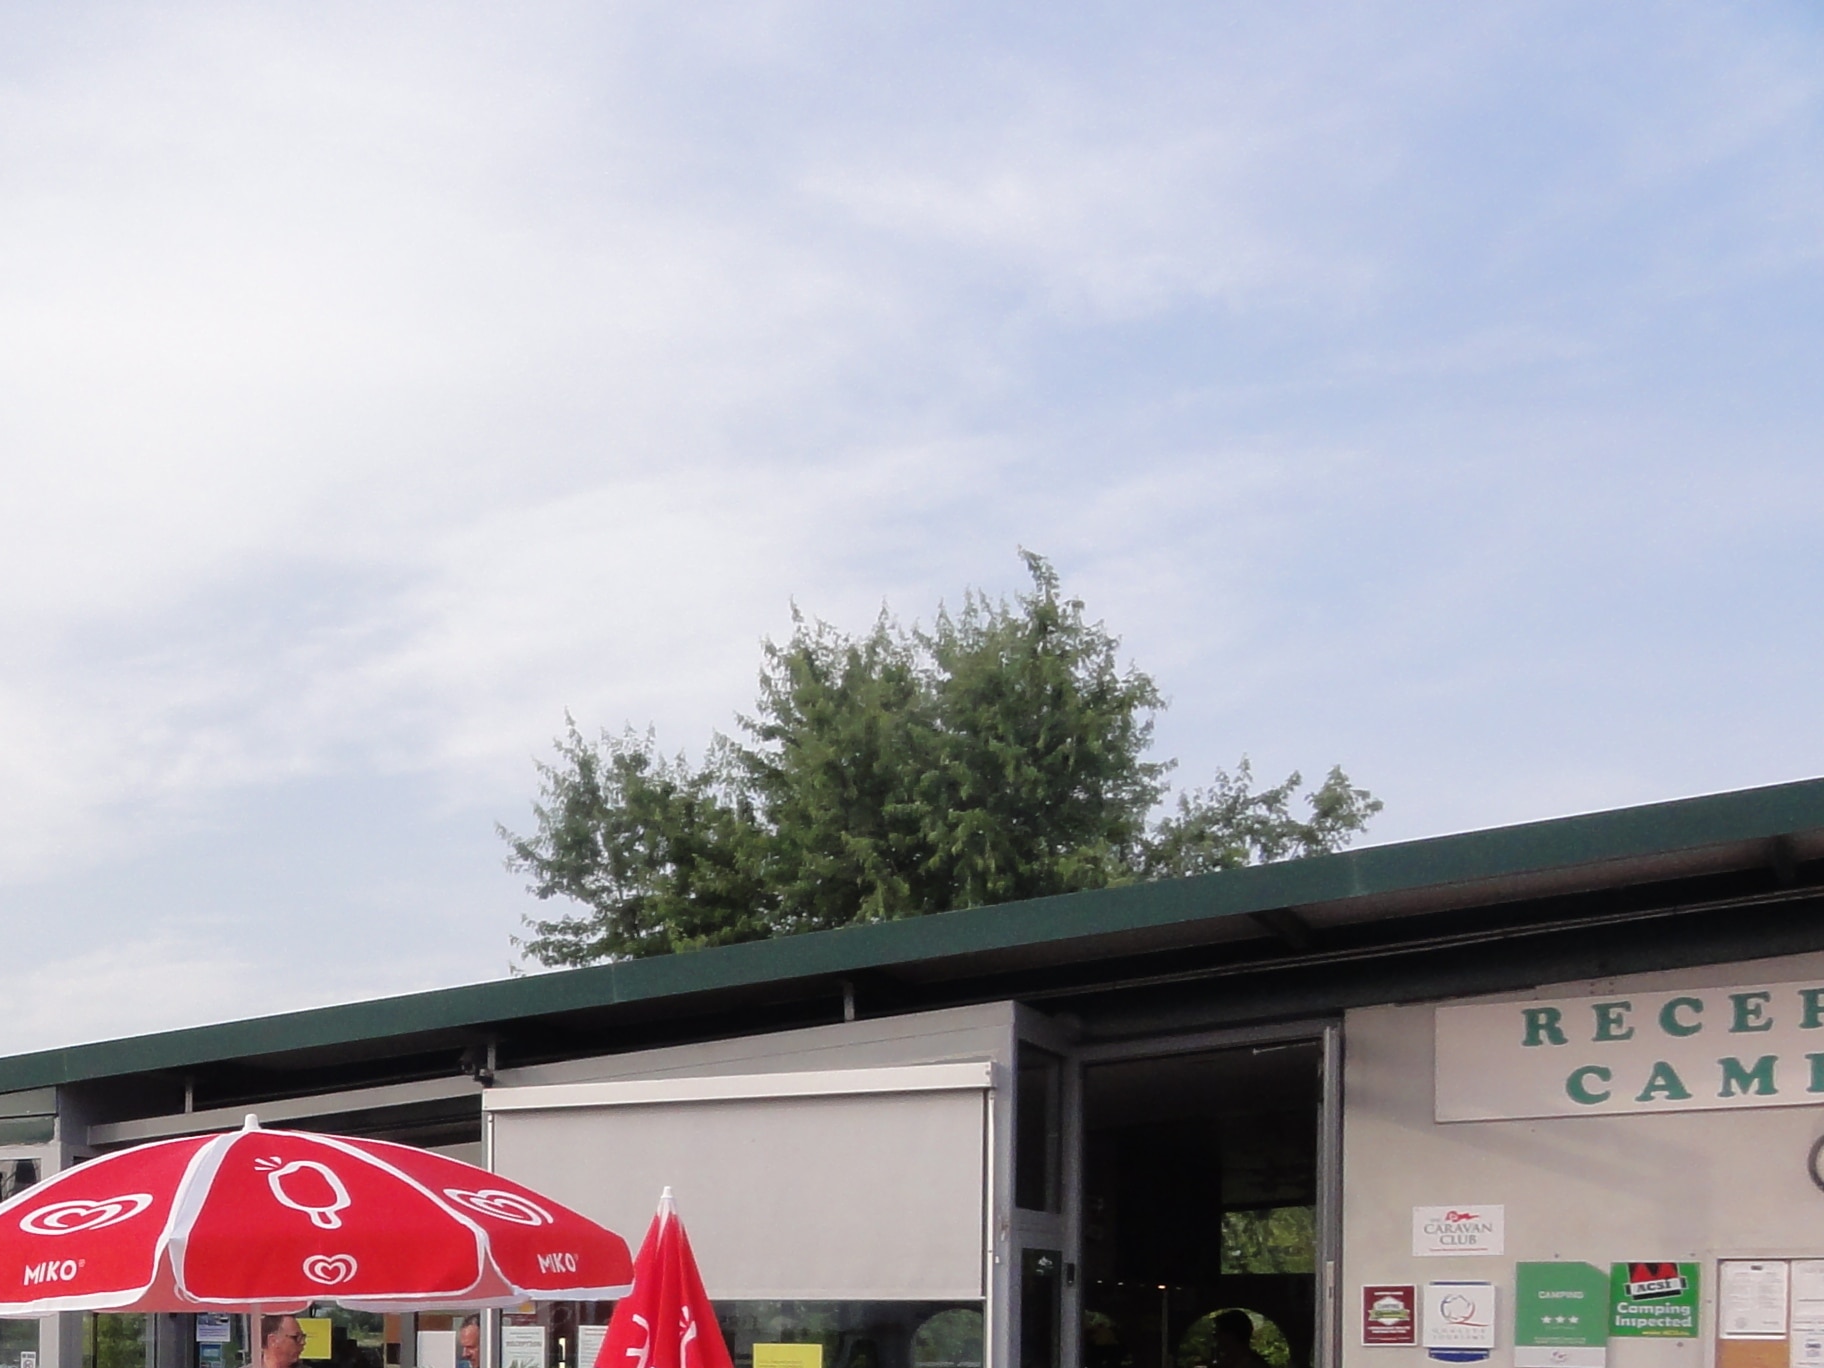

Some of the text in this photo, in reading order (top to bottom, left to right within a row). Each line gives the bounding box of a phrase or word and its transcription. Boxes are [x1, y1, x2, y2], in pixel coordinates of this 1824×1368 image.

[1424, 1223, 1493, 1234] CARAVAN
[1440, 1234, 1477, 1245] CLUB
[1617, 1302, 1691, 1316] Camping
[1615, 1315, 1693, 1328] Inspected
